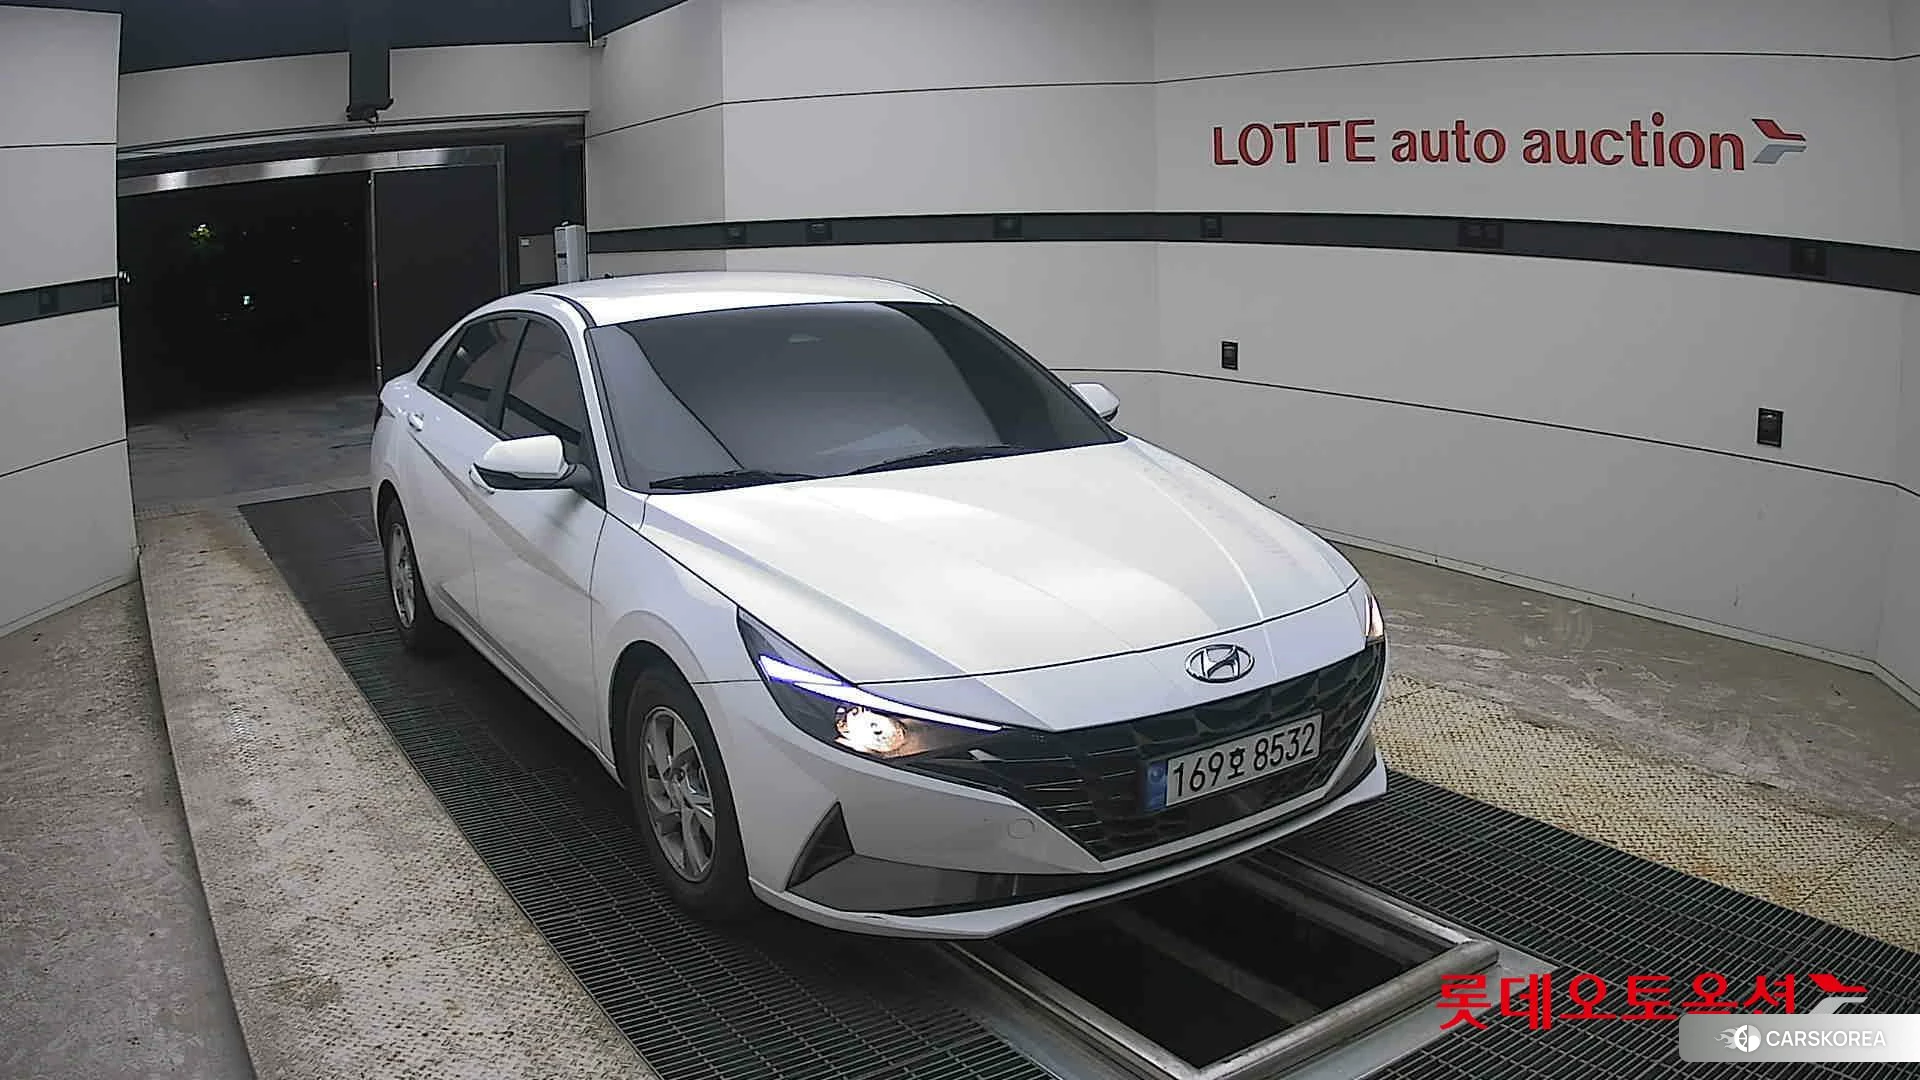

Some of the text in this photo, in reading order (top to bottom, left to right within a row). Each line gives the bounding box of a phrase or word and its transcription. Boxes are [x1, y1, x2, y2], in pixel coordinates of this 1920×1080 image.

[1213, 112, 1746, 171] LOTTE auto auction
[1253, 722, 1316, 772] 8532
